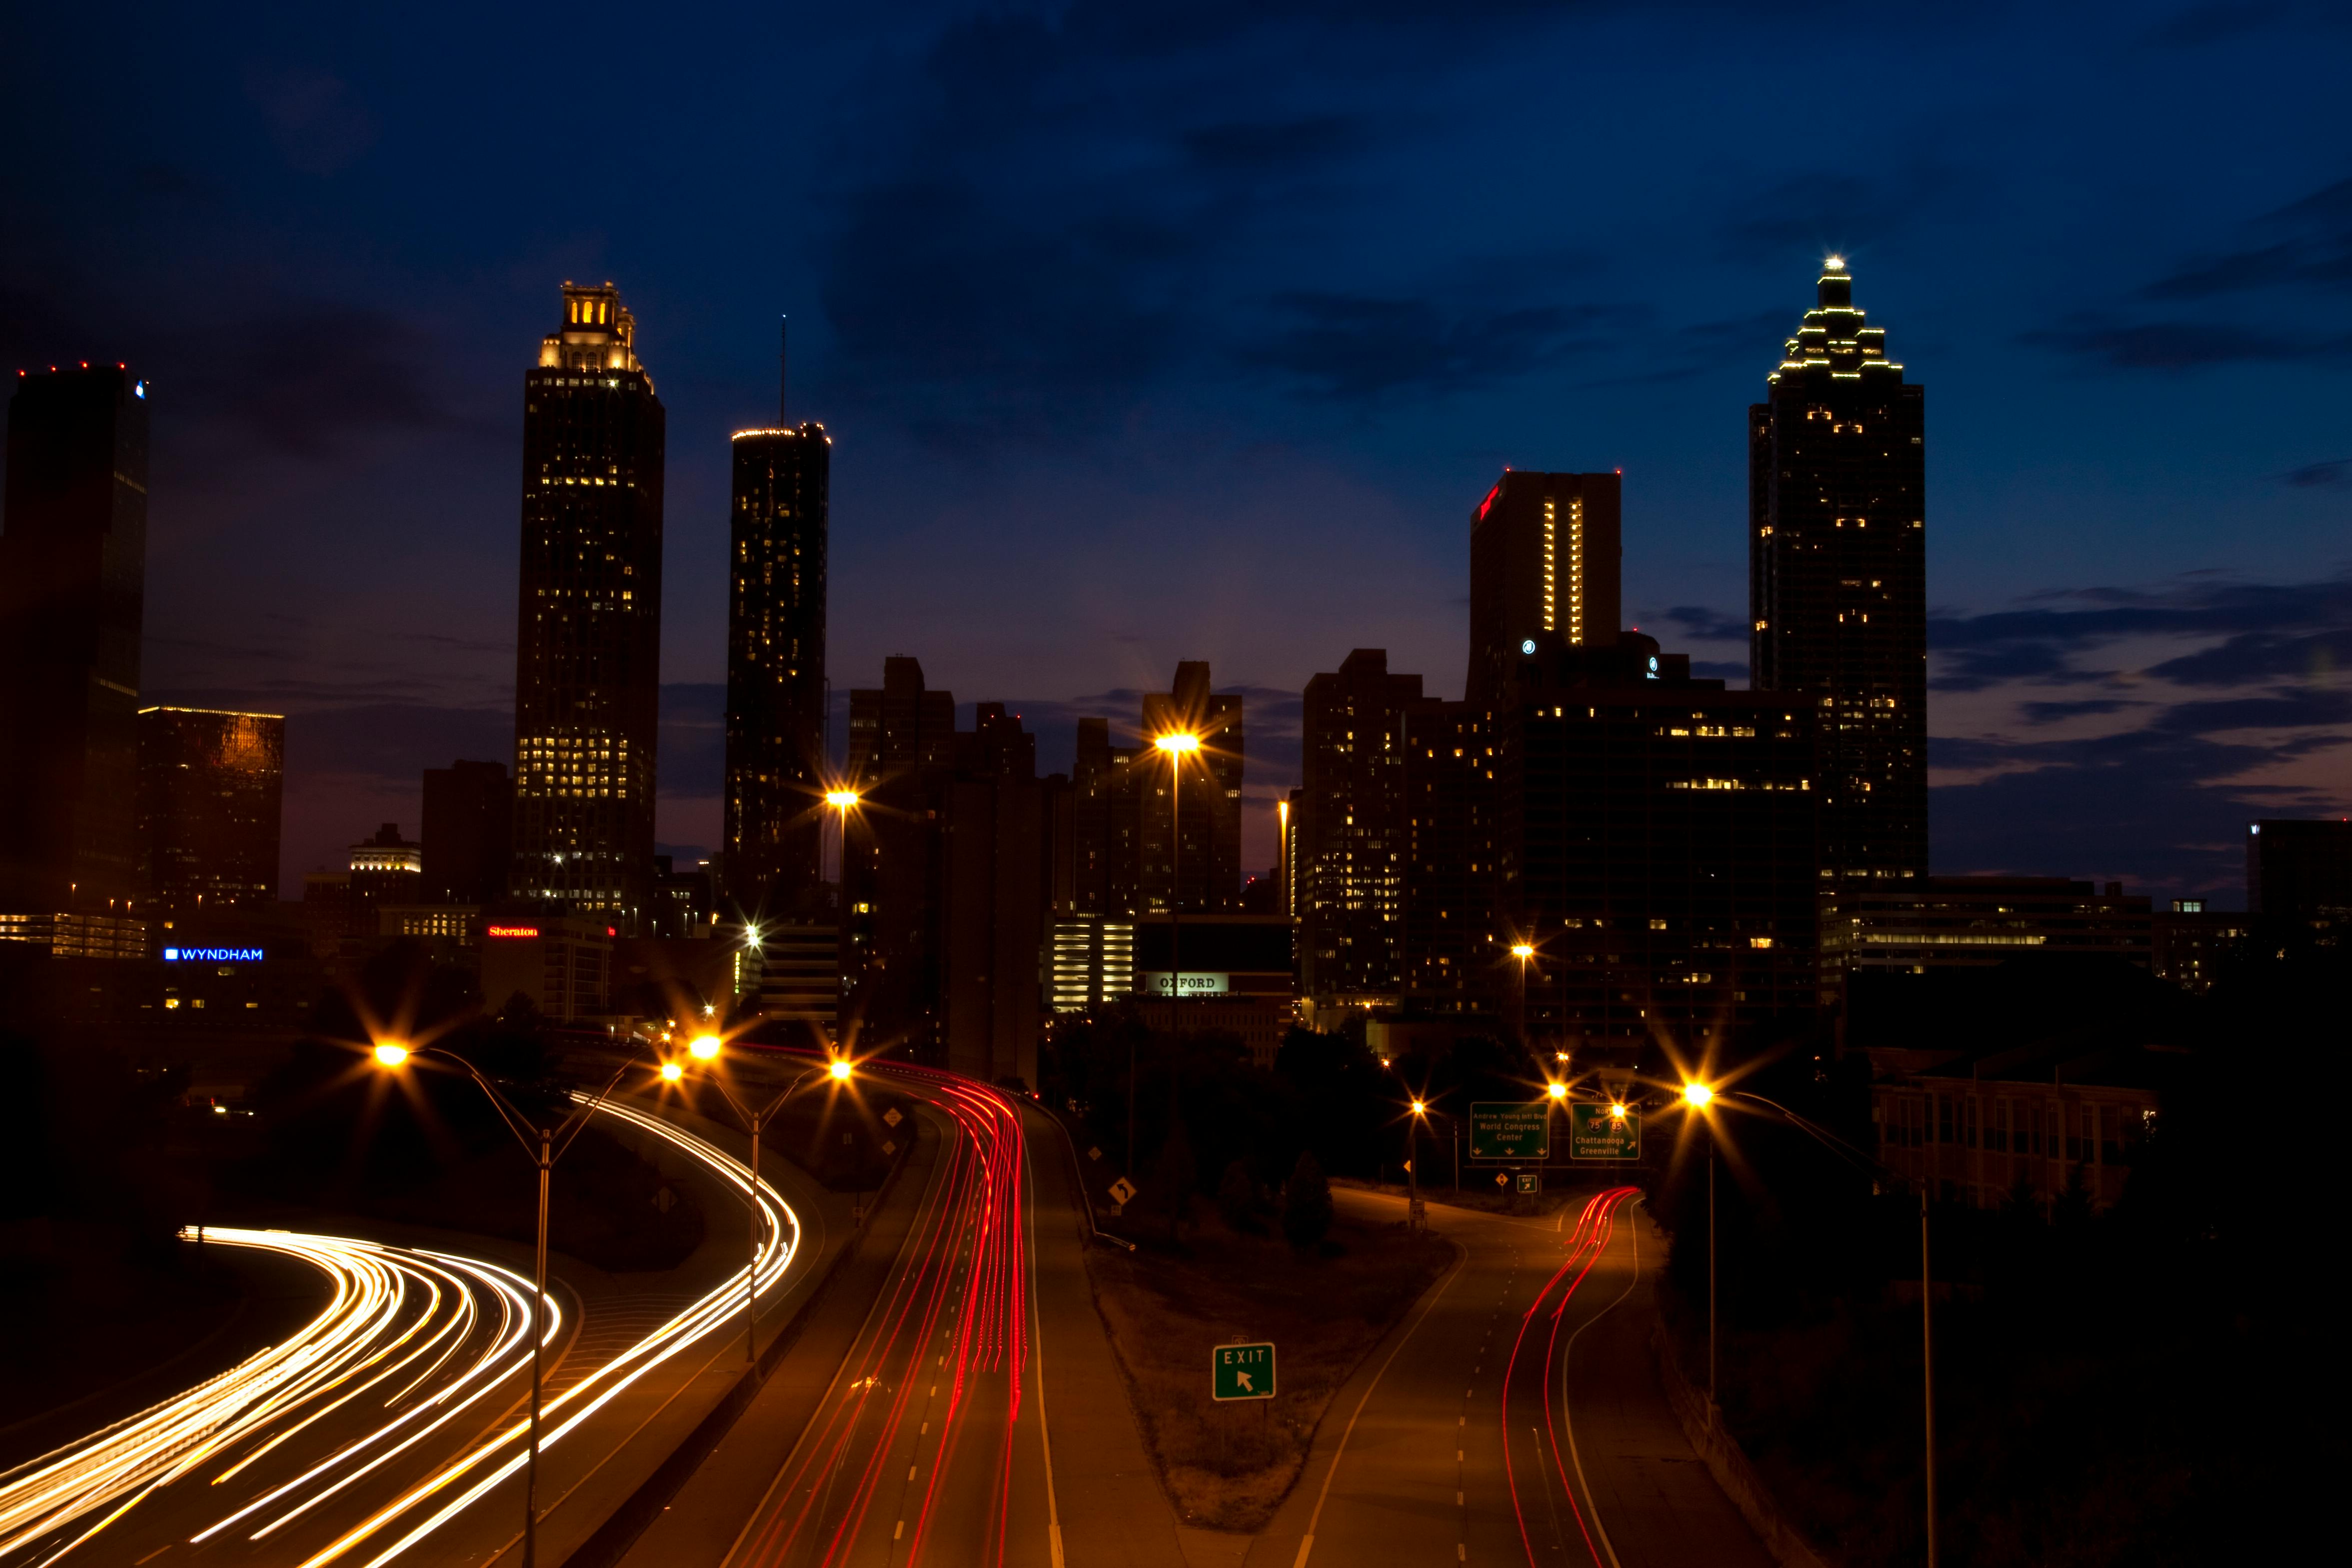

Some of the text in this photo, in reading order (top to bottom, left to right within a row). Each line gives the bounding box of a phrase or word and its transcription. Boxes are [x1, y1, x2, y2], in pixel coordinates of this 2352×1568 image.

[489, 927, 537, 936] Sheraton
[182, 949, 262, 960] WYNDHAM
[1504, 1123, 1540, 1132] Congress
[1575, 1136, 1624, 1146] Chattanooga
[1224, 1350, 1264, 1365] EXIT
